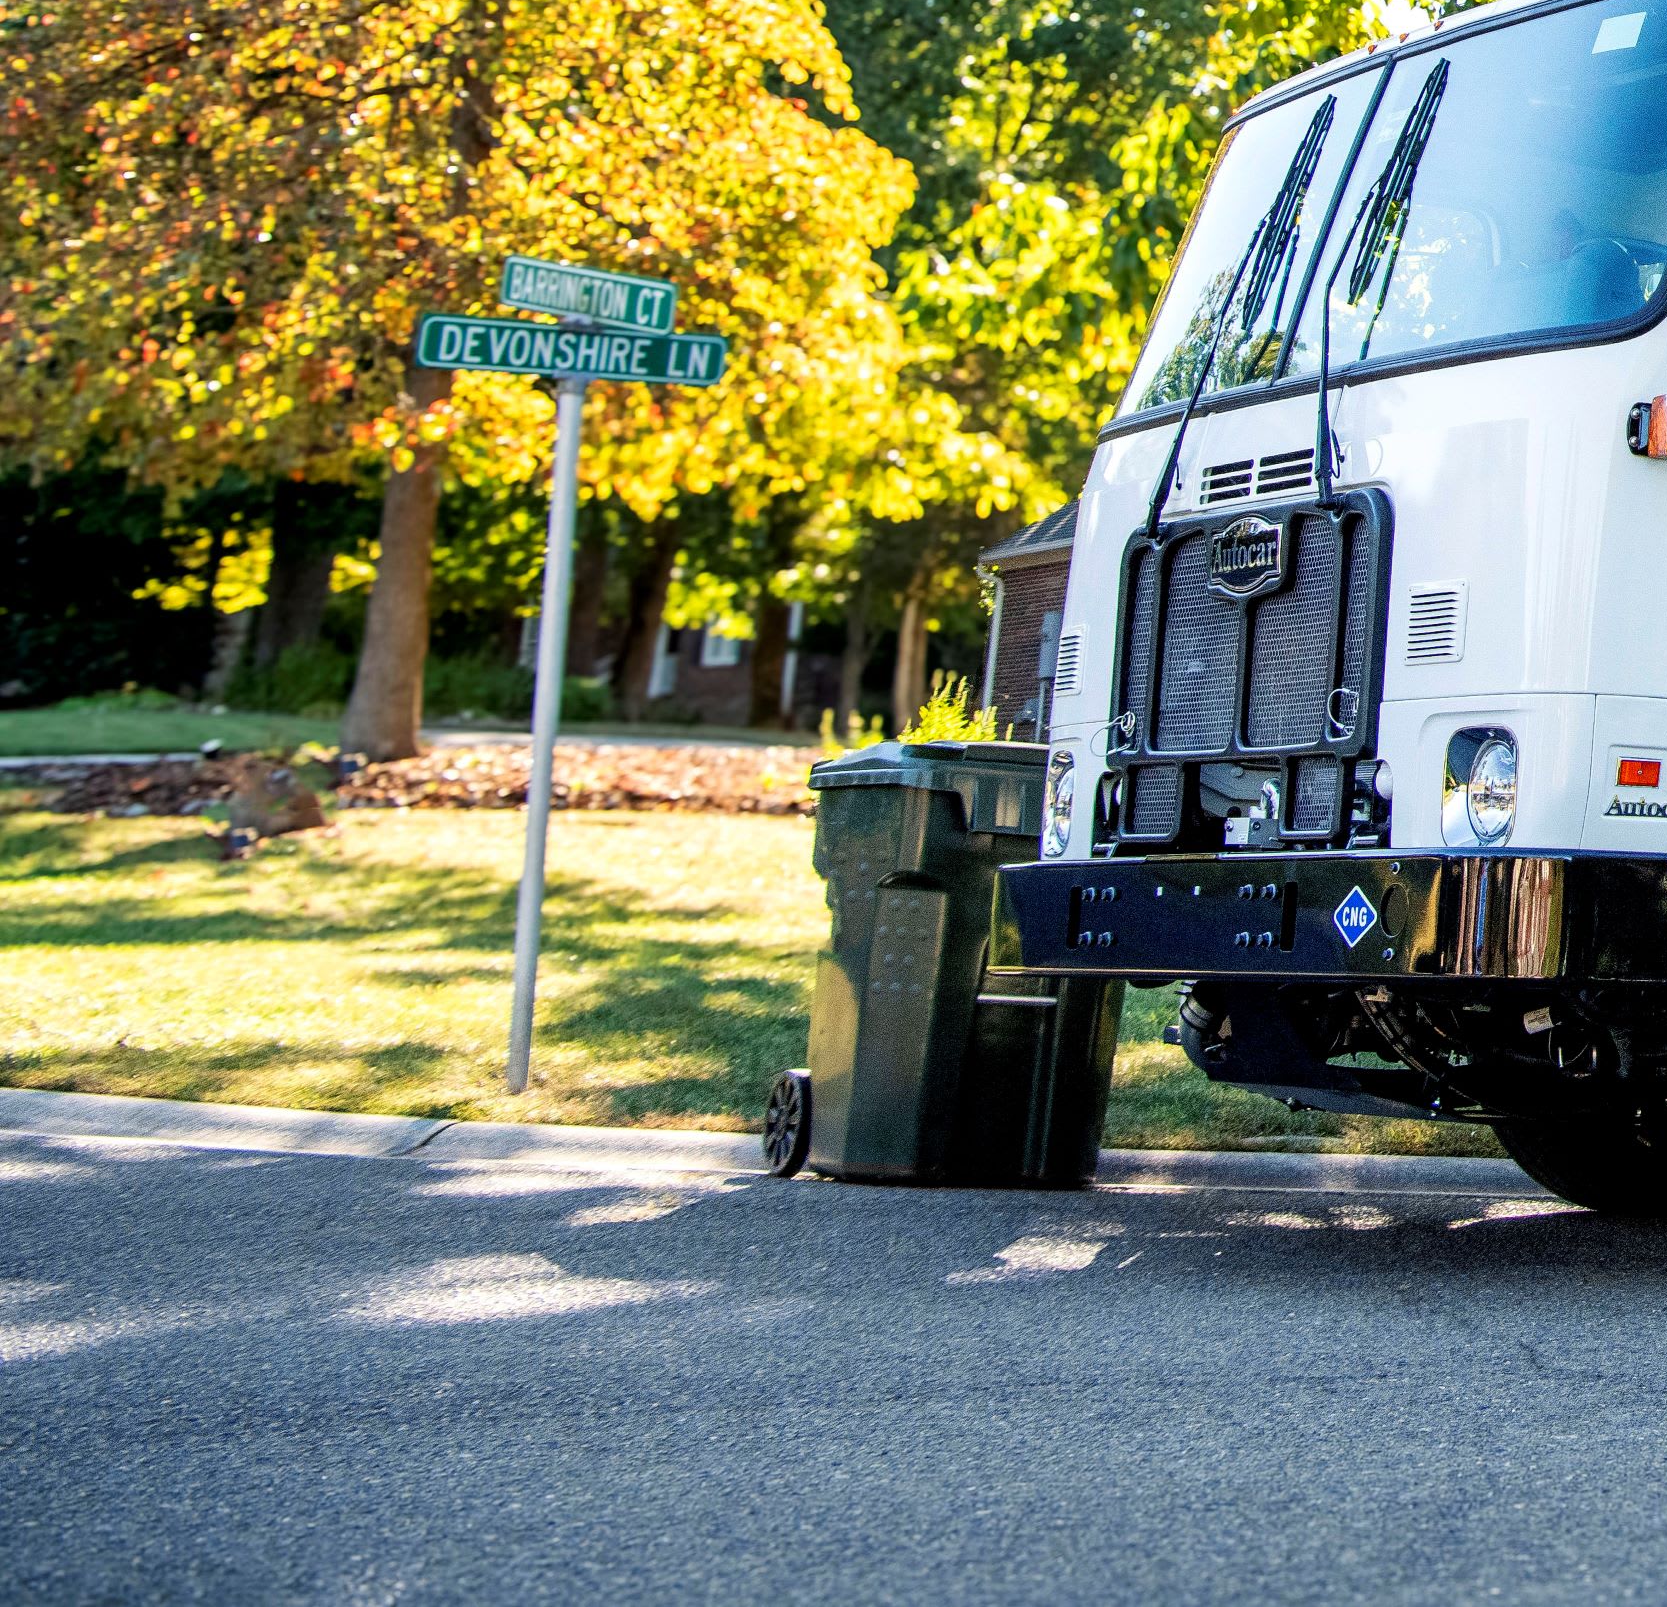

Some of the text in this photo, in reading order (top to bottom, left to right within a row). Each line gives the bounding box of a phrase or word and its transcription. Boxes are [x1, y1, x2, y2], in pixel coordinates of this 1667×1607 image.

[510, 265, 666, 327] BARRINGTON CT
[438, 324, 711, 378] DEVONSHIRE LN
[1212, 538, 1277, 574] Autocar
[1342, 906, 1368, 928] CNG
